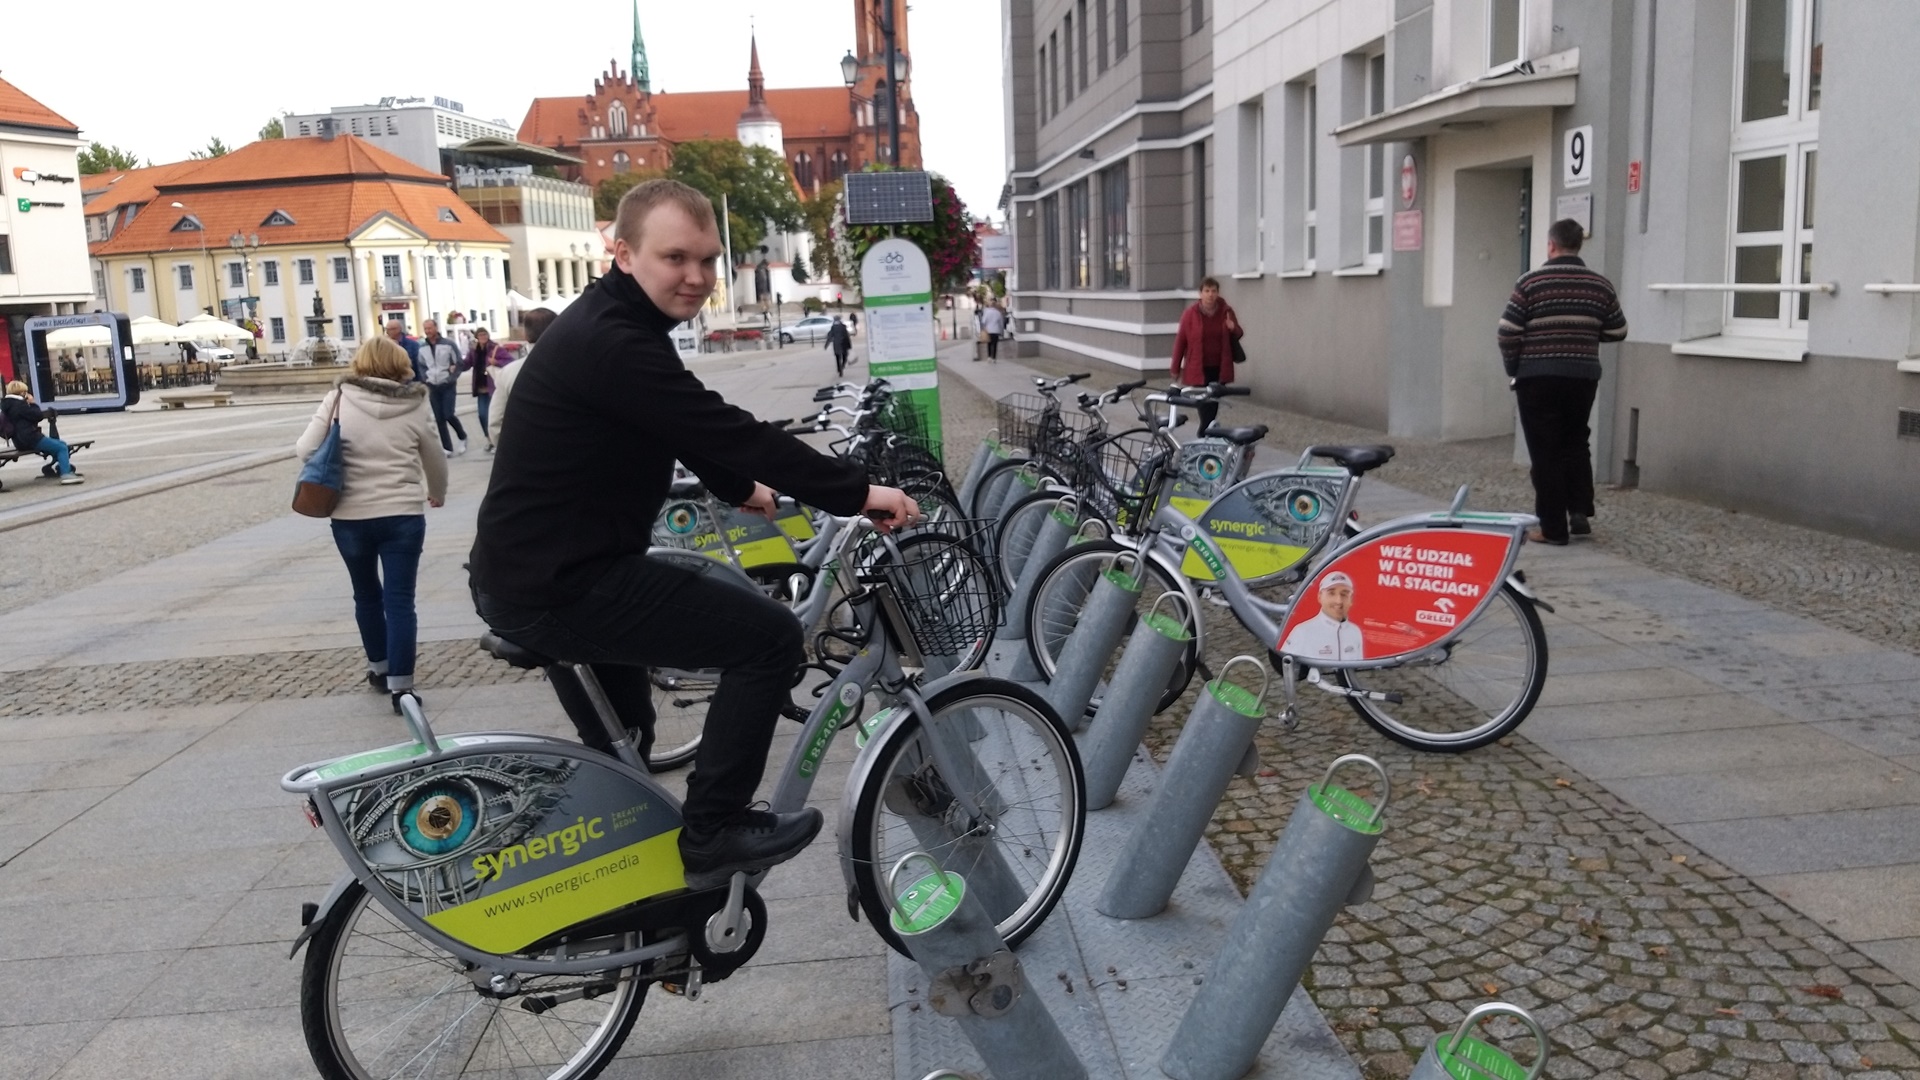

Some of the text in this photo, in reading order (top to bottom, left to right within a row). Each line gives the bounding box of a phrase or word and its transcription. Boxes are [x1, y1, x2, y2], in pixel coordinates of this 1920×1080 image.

[1571, 131, 1585, 175] 9
[694, 524, 748, 549] syngic
[1210, 519, 1266, 537] synergic
[1380, 544, 1473, 567] WEŹ UDZIAŁ
[1379, 559, 1454, 579] W LOTERII
[1378, 574, 1479, 597] NA STACJACH
[1418, 612, 1453, 624] ORLEN
[811, 708, 842, 758] 85407
[612, 816, 637, 832] MEDIA
[472, 816, 605, 881] synergic
[484, 854, 640, 918] www.synergic.media
